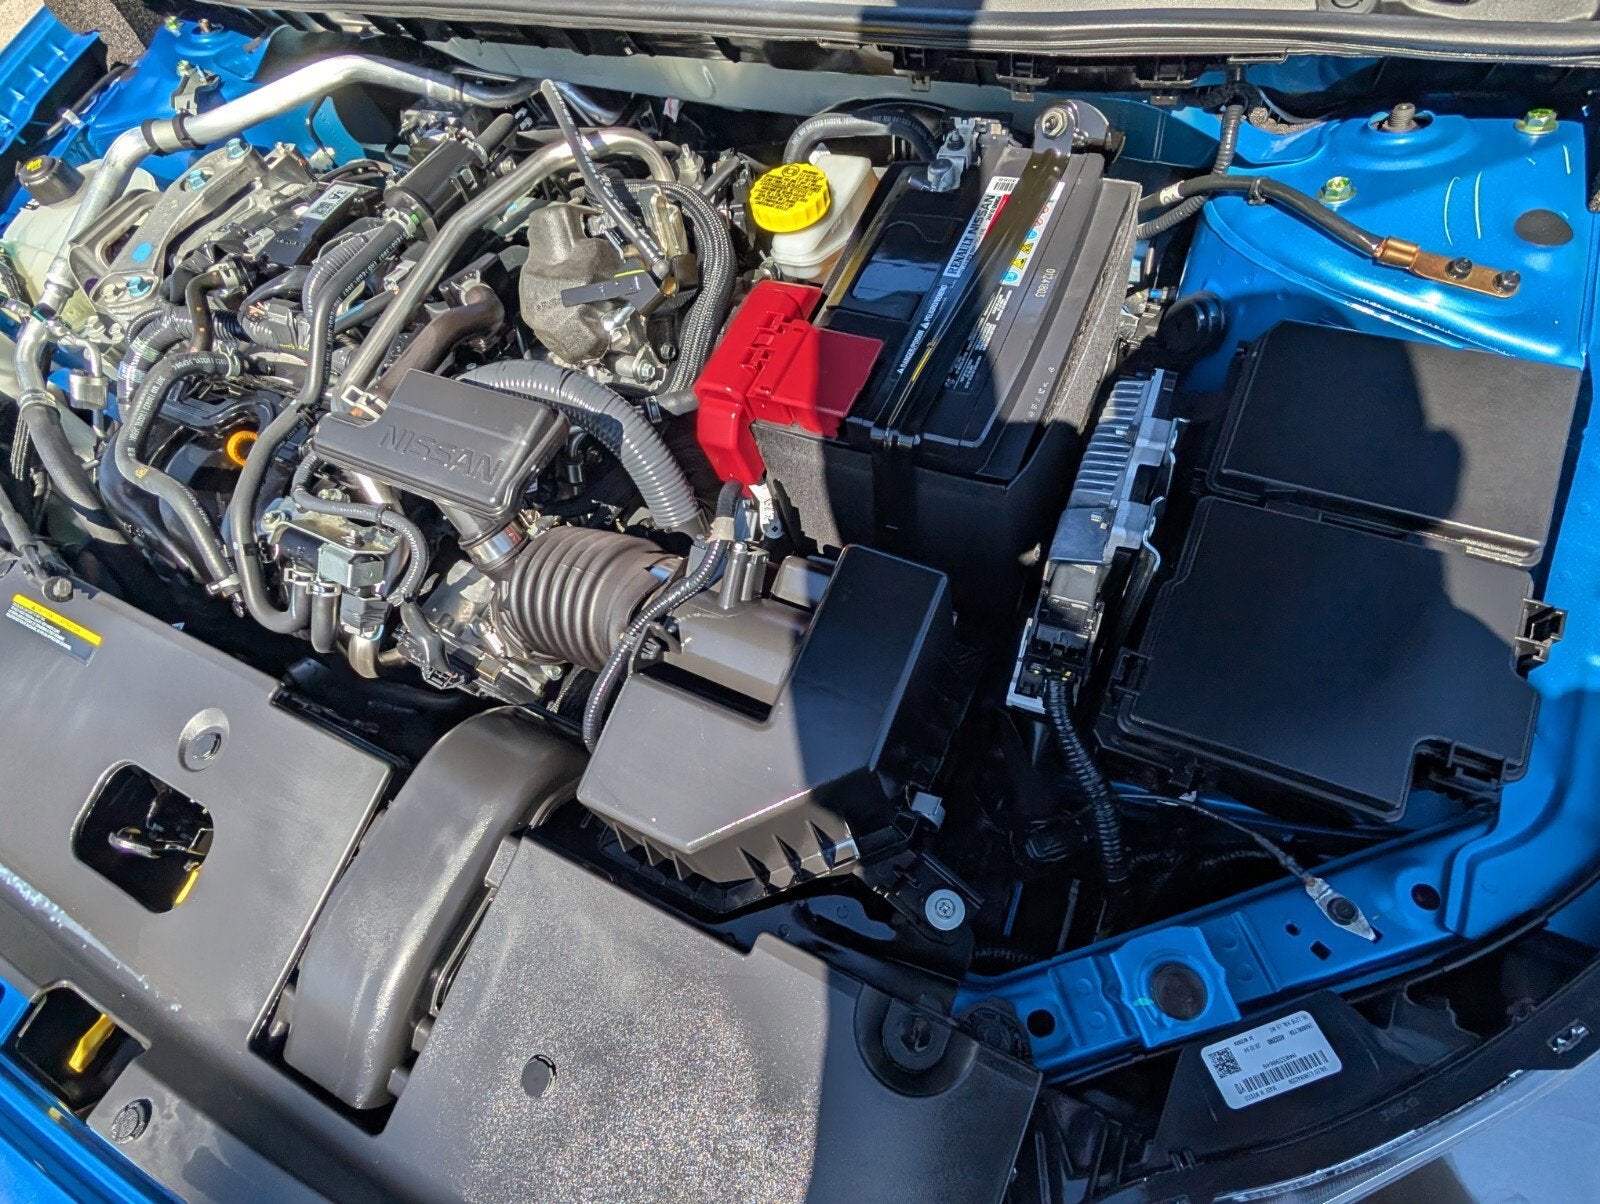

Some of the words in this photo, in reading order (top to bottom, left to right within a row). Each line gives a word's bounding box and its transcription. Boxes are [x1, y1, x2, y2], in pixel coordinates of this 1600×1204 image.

[947, 232, 973, 275] RENAULT
[971, 194, 996, 235] NISSAN
[379, 425, 503, 484] NISSAN
